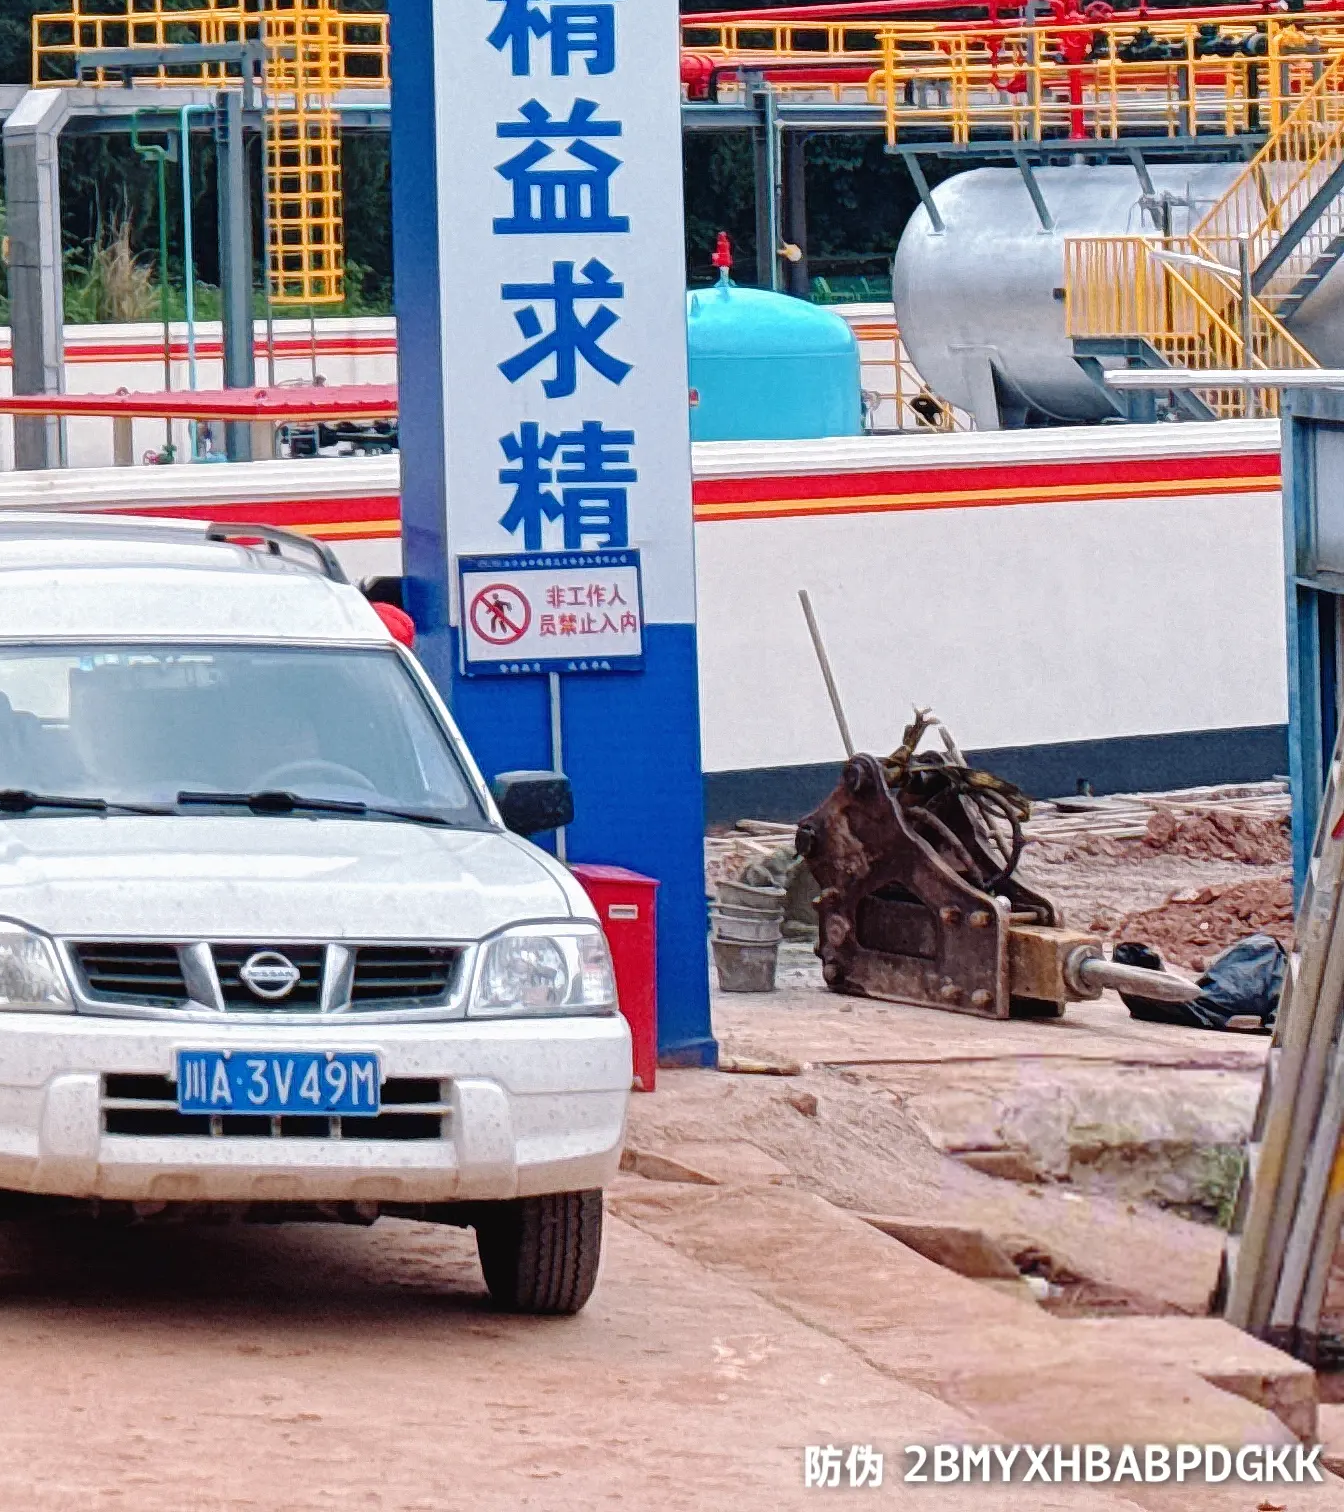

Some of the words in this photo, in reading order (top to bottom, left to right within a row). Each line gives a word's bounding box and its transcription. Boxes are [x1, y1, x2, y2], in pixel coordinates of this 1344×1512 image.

[546, 583, 627, 609] 非工作人
[539, 611, 637, 637] 员禁止入内
